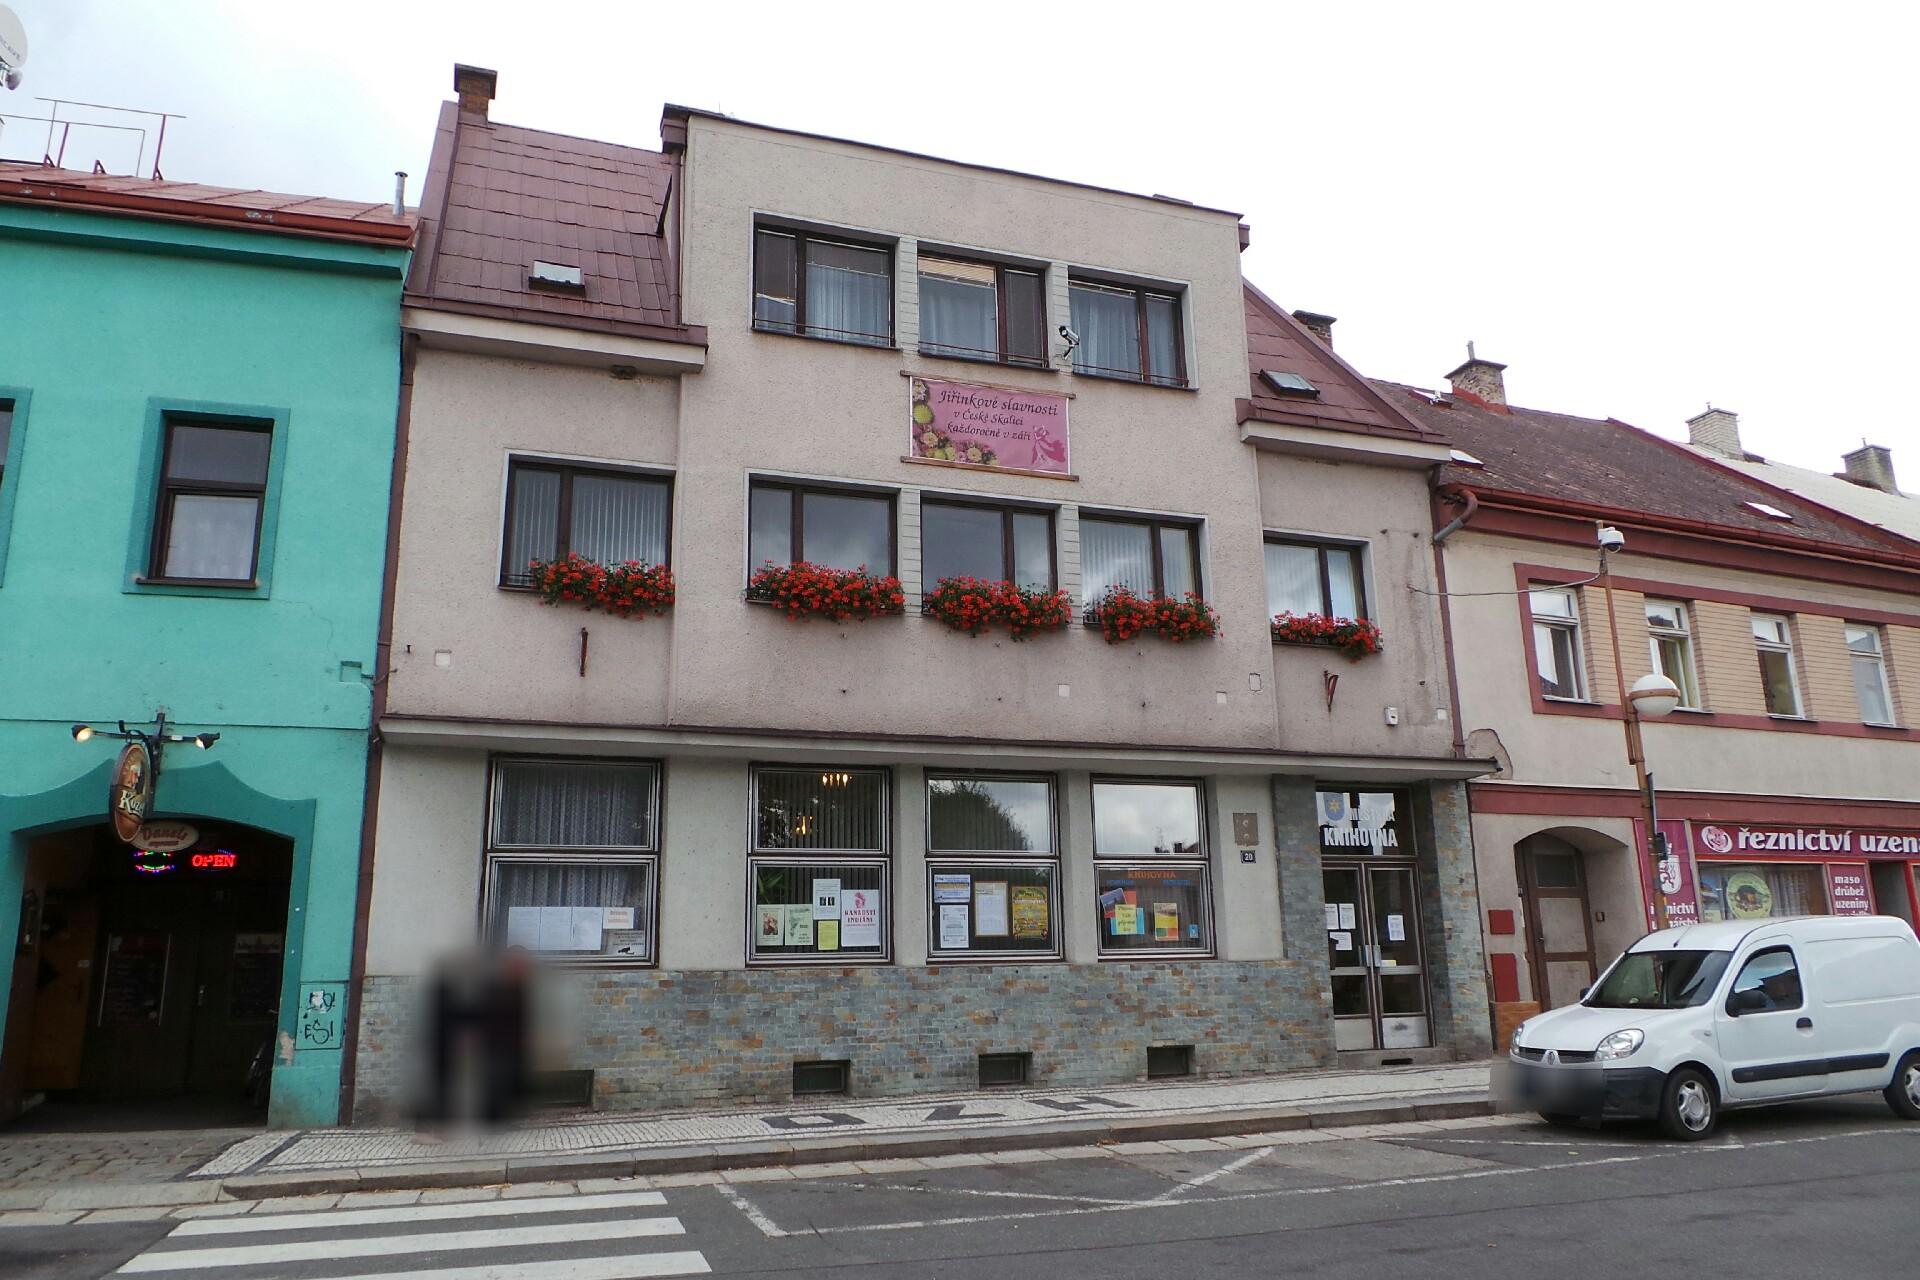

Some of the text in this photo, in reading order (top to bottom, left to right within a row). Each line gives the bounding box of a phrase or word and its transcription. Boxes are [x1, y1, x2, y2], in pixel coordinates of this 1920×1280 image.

[938, 390, 1058, 416] Jiřinkové slavnosti
[962, 409, 989, 422] České
[990, 414, 1024, 426] Skalici
[947, 421, 1001, 437] každoročně
[1012, 430, 1031, 441] září
[1323, 827, 1398, 847] KNIHOVNA
[1738, 827, 1853, 851] řeznictví
[191, 854, 237, 868] OPEN
[1244, 853, 1253, 861] 20
[1834, 876, 1861, 884] maso
[1834, 886, 1865, 896] drůbež
[1836, 898, 1869, 911] uzeniny
